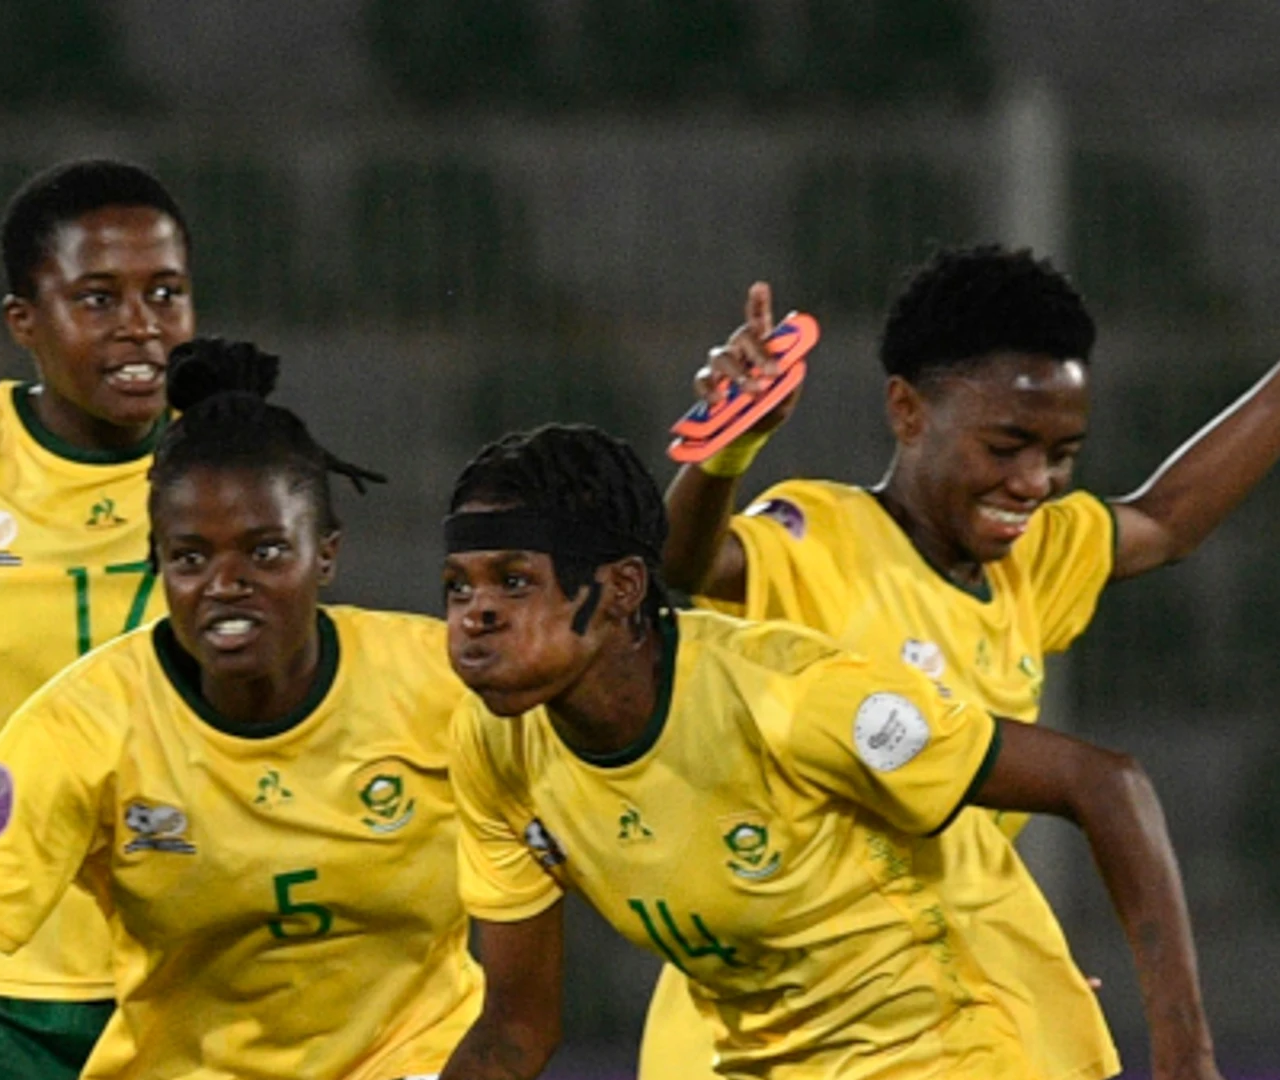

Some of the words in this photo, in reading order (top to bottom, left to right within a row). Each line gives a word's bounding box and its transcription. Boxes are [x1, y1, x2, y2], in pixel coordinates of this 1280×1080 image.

[66, 562, 154, 657] 17
[268, 869, 332, 942] 5
[626, 898, 750, 977] 14
